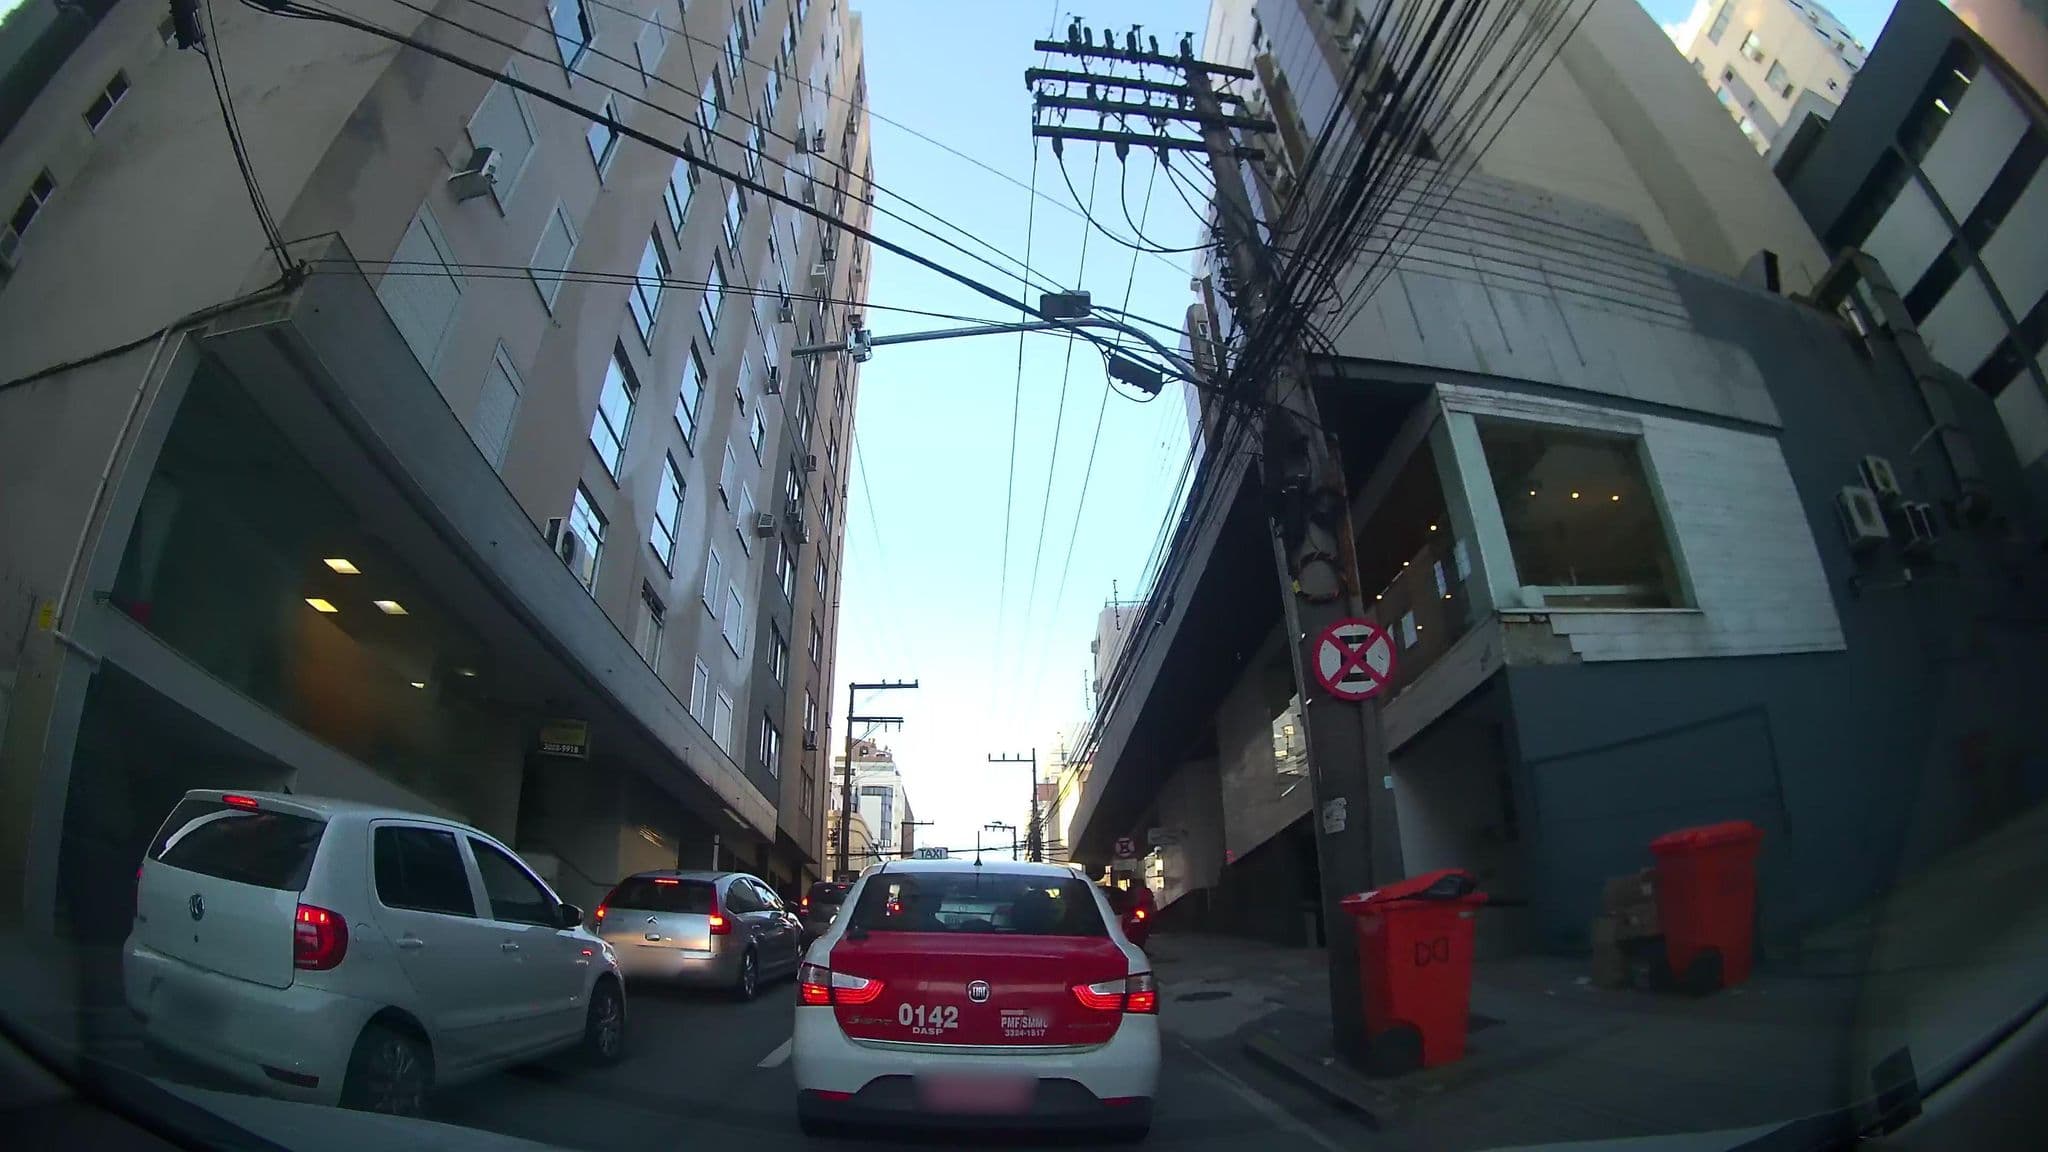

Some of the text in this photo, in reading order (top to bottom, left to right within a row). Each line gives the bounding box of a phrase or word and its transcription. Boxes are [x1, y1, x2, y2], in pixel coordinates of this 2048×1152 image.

[920, 849, 943, 859] TAXI
[898, 1003, 959, 1029] 0142
[912, 1027, 944, 1036] DASP
